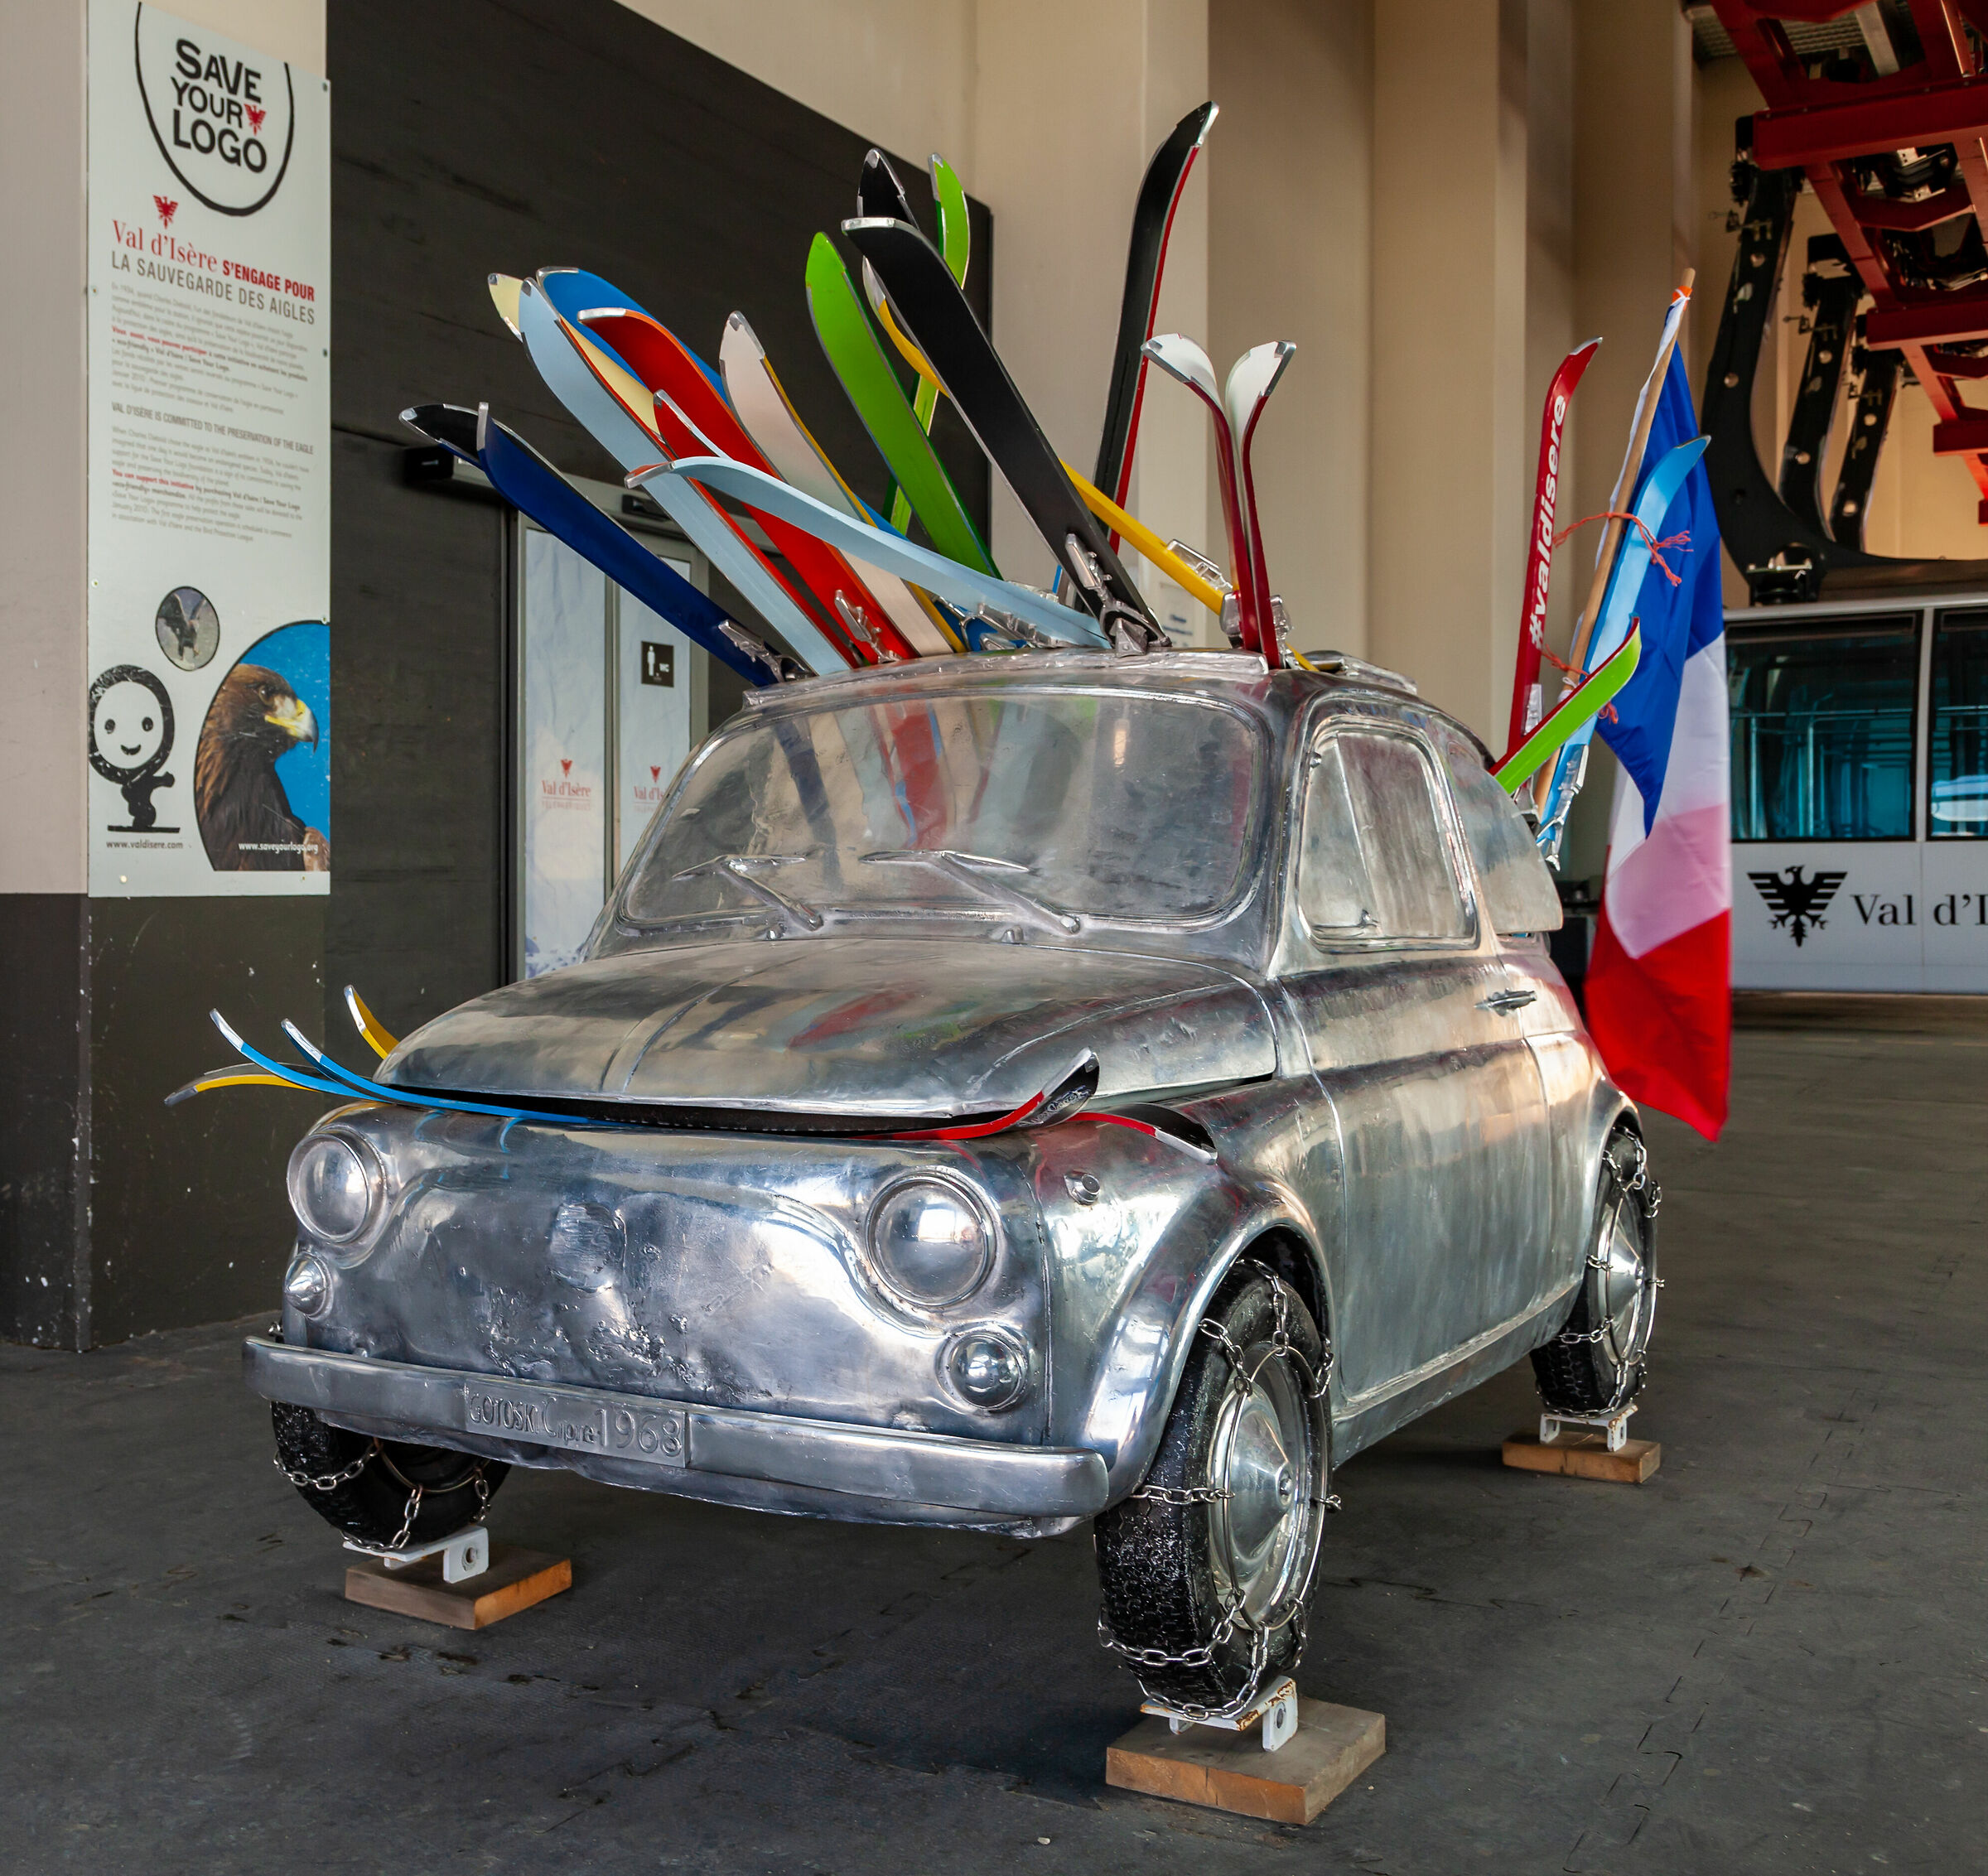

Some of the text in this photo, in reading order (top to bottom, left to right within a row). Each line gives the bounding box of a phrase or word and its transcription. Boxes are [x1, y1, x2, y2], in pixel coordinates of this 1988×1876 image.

[175, 38, 262, 104] SAVE
[171, 76, 243, 128] YOUR
[172, 109, 268, 173] LOGO
[112, 219, 315, 301] Val d'Isère S'ENGAGE POUR
[112, 250, 130, 272] LA
[137, 258, 233, 301] SAUVEGARDE
[239, 287, 264, 311] DES
[269, 297, 315, 326] AIGLES
[112, 402, 124, 413] VAL
[1530, 395, 1566, 649] #valdisere
[542, 780, 591, 797] Val d'Isère
[634, 786, 664, 802] Val d'Is
[106, 840, 183, 849] www.valdisere.com
[239, 842, 318, 855] www.saveyourlogo.org
[1850, 894, 1917, 926] Val
[595, 1408, 682, 1458] 1968
